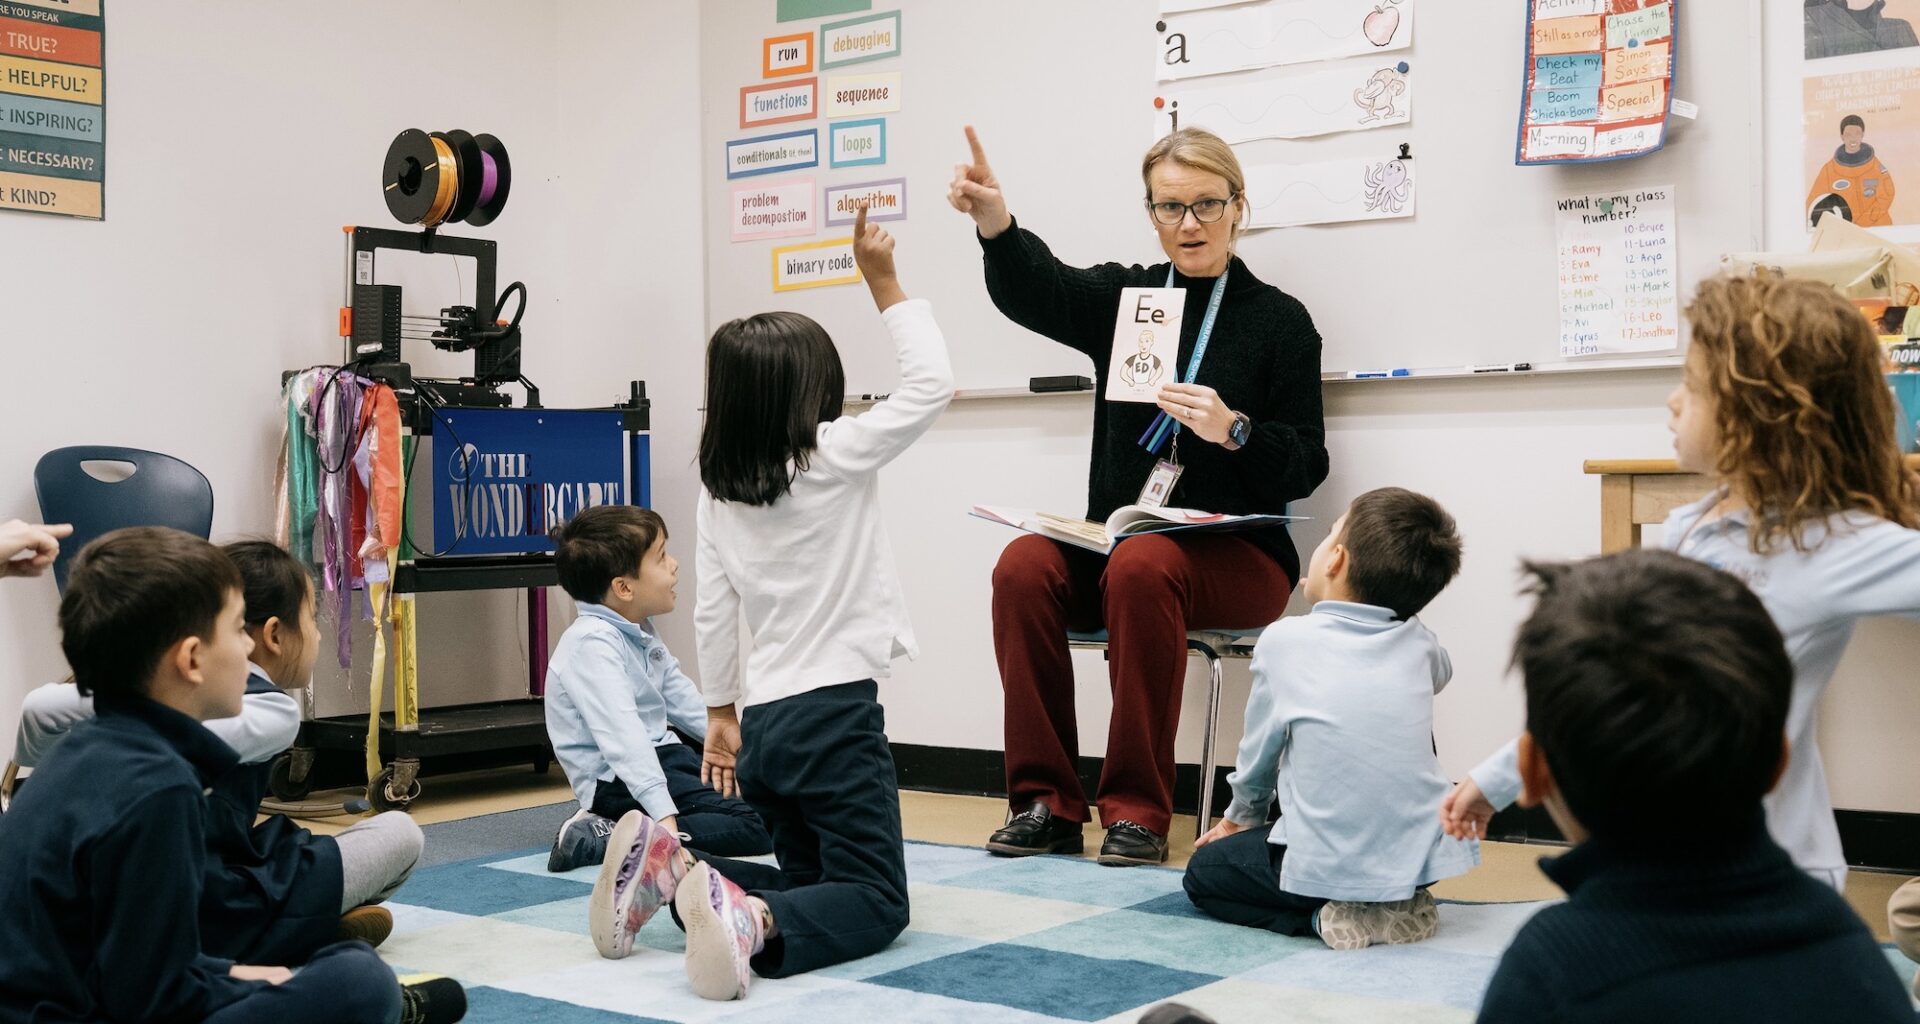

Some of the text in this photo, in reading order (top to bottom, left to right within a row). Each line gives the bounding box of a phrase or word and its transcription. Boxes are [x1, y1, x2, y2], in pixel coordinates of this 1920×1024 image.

[11, 7, 30, 18] YOU
[32, 10, 60, 23] SPEAK
[1608, 9, 1666, 30] Chase the
[7, 32, 58, 54] TRUE?
[833, 30, 891, 54] debugging
[1535, 28, 1560, 43] Still
[1561, 32, 1571, 40] as
[778, 47, 798, 62] run
[1164, 32, 1190, 65] a
[1616, 50, 1651, 63] Simon
[1536, 56, 1600, 71] Check my
[1615, 63, 1648, 80] Says
[8, 68, 88, 93] HELPFUL?
[1550, 70, 1580, 86] Beat
[754, 86, 889, 113] functions sequence
[1547, 91, 1580, 103] Boom
[10, 108, 93, 133] INSPIRING?
[843, 135, 873, 154] loops
[8, 148, 94, 171] NECESSARY?
[737, 147, 787, 165] conditionals
[11, 187, 57, 207] KIND?
[742, 192, 779, 211] problem
[1557, 196, 1589, 211] What
[1611, 195, 1629, 208] my
[1636, 191, 1666, 203] class
[742, 208, 807, 226] decompostion
[1582, 205, 1637, 224] number?
[786, 253, 854, 276] binary code
[1135, 294, 1165, 324] Ee
[1135, 362, 1149, 374] ED
[481, 453, 532, 478] THE
